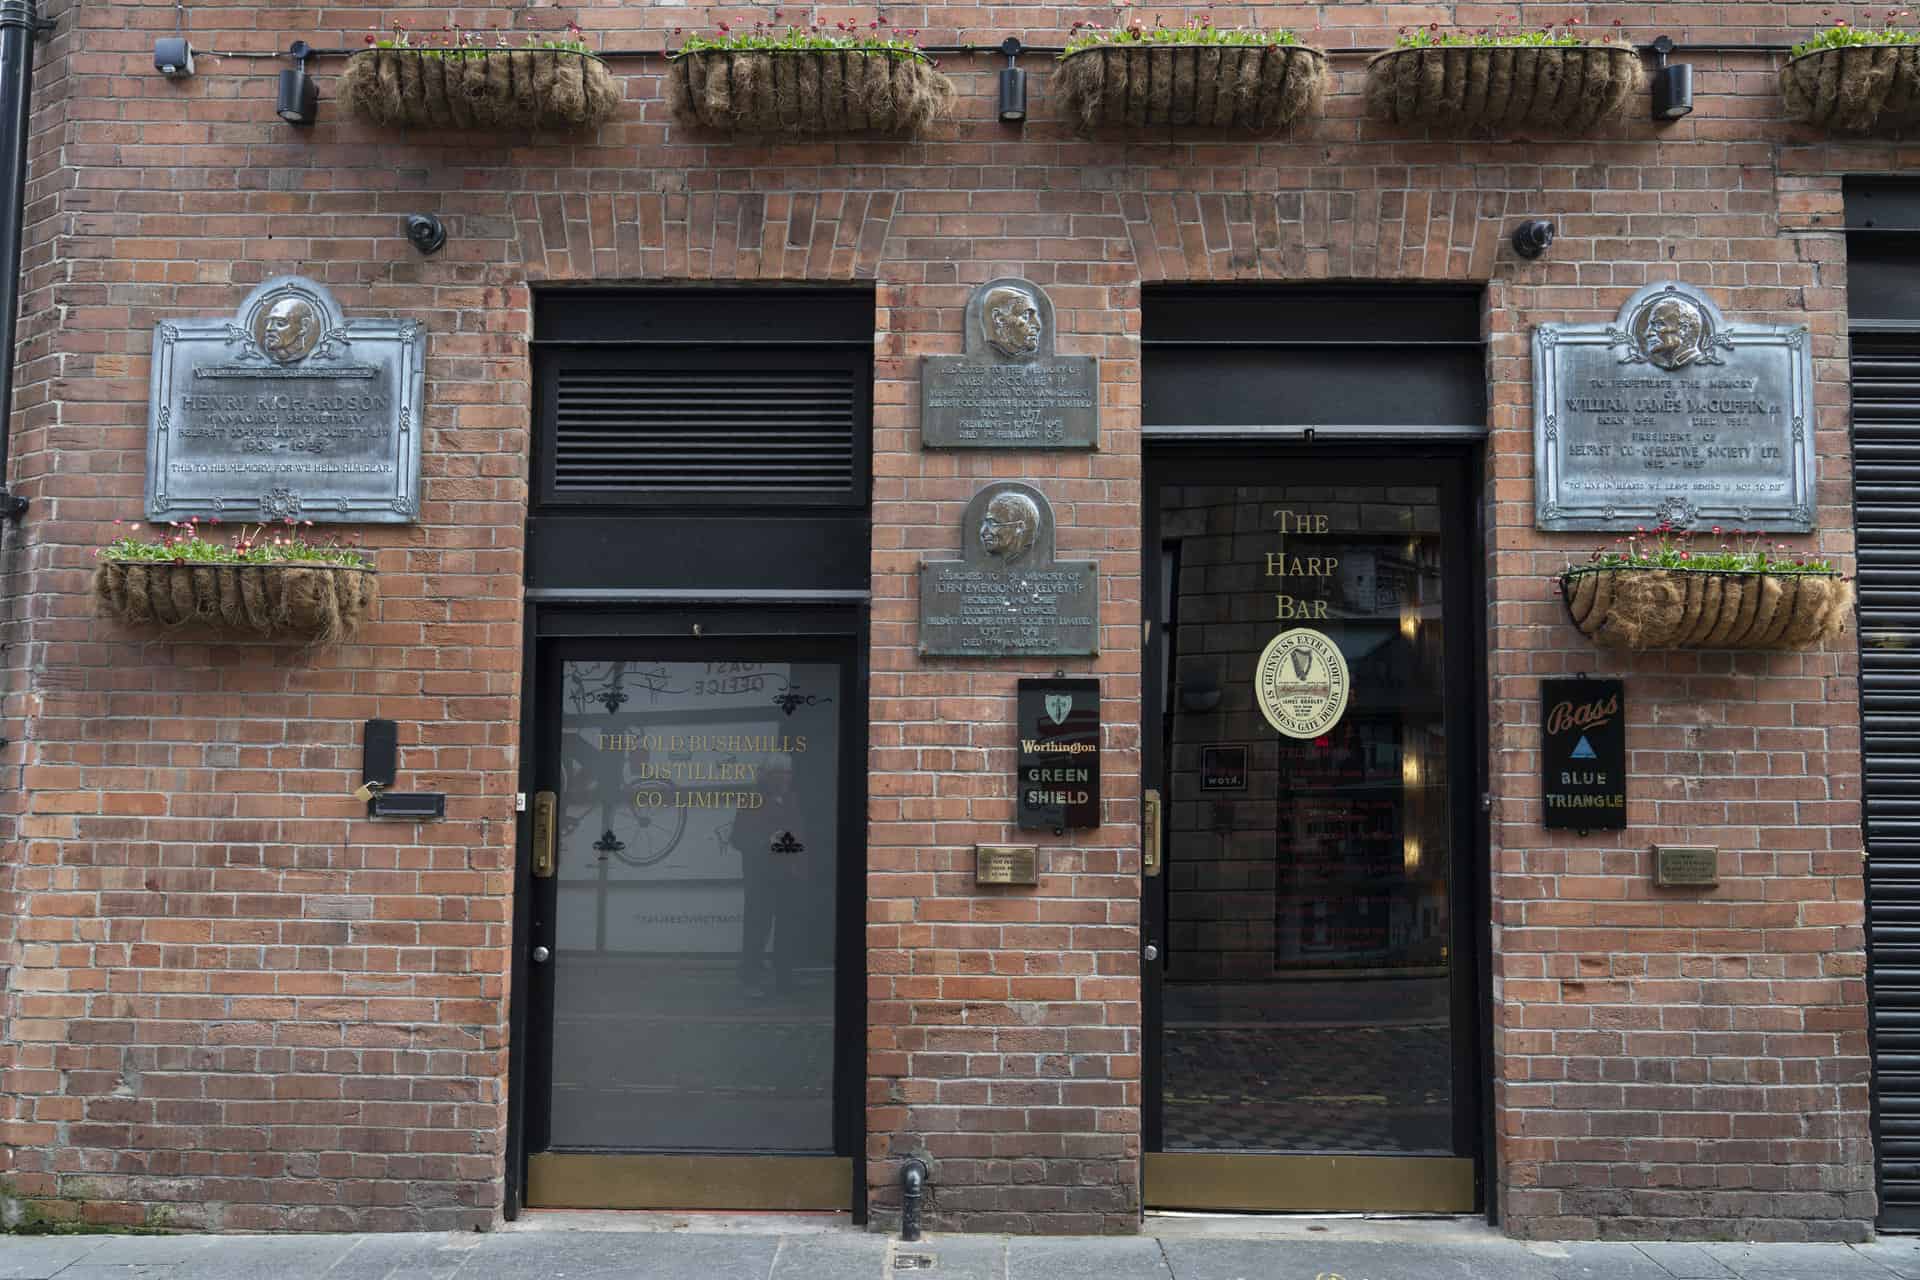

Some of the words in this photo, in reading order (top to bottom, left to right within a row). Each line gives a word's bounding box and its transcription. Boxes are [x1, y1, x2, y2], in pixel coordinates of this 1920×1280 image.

[1709, 379, 1754, 389] MEMORY
[182, 393, 248, 411] HENRY
[256, 393, 388, 411] RICHARDSON
[1566, 398, 1631, 413] WILLIAM
[1634, 398, 1682, 413] JAMES
[206, 414, 279, 425] MANAGING
[287, 414, 365, 425] SECRETARY
[1568, 444, 1612, 456] BELFAST
[1706, 446, 1753, 458] SOCIETY
[171, 463, 192, 473] THIS
[195, 463, 208, 473] TO
[211, 463, 226, 473] HIS
[274, 463, 293, 473] FOR
[296, 463, 311, 473] WE
[314, 463, 340, 473] HELD
[1273, 510, 1329, 534] THE
[1264, 552, 1339, 576] HARP
[1275, 595, 1329, 619] BAR
[1265, 638, 1295, 686] GUINNESS
[1297, 635, 1328, 656] EXTRA
[1327, 655, 1341, 685] STOUT
[1297, 720, 1319, 731] GATE
[1319, 692, 1339, 722] DUBLIN
[1546, 693, 1618, 735] Bass
[598, 735, 638, 753] THE
[643, 735, 684, 753] OLD
[687, 735, 807, 753] BUSHMILLS
[1020, 739, 1097, 754] Worthington
[639, 762, 758, 781] DISTILLERY
[1028, 768, 1089, 782] GREEN
[1561, 771, 1607, 785] BLUE
[635, 791, 669, 809] CO.
[675, 791, 763, 809] LIMITED
[1028, 791, 1089, 805] SHIELD
[1546, 793, 1625, 808] TRIANGLE
